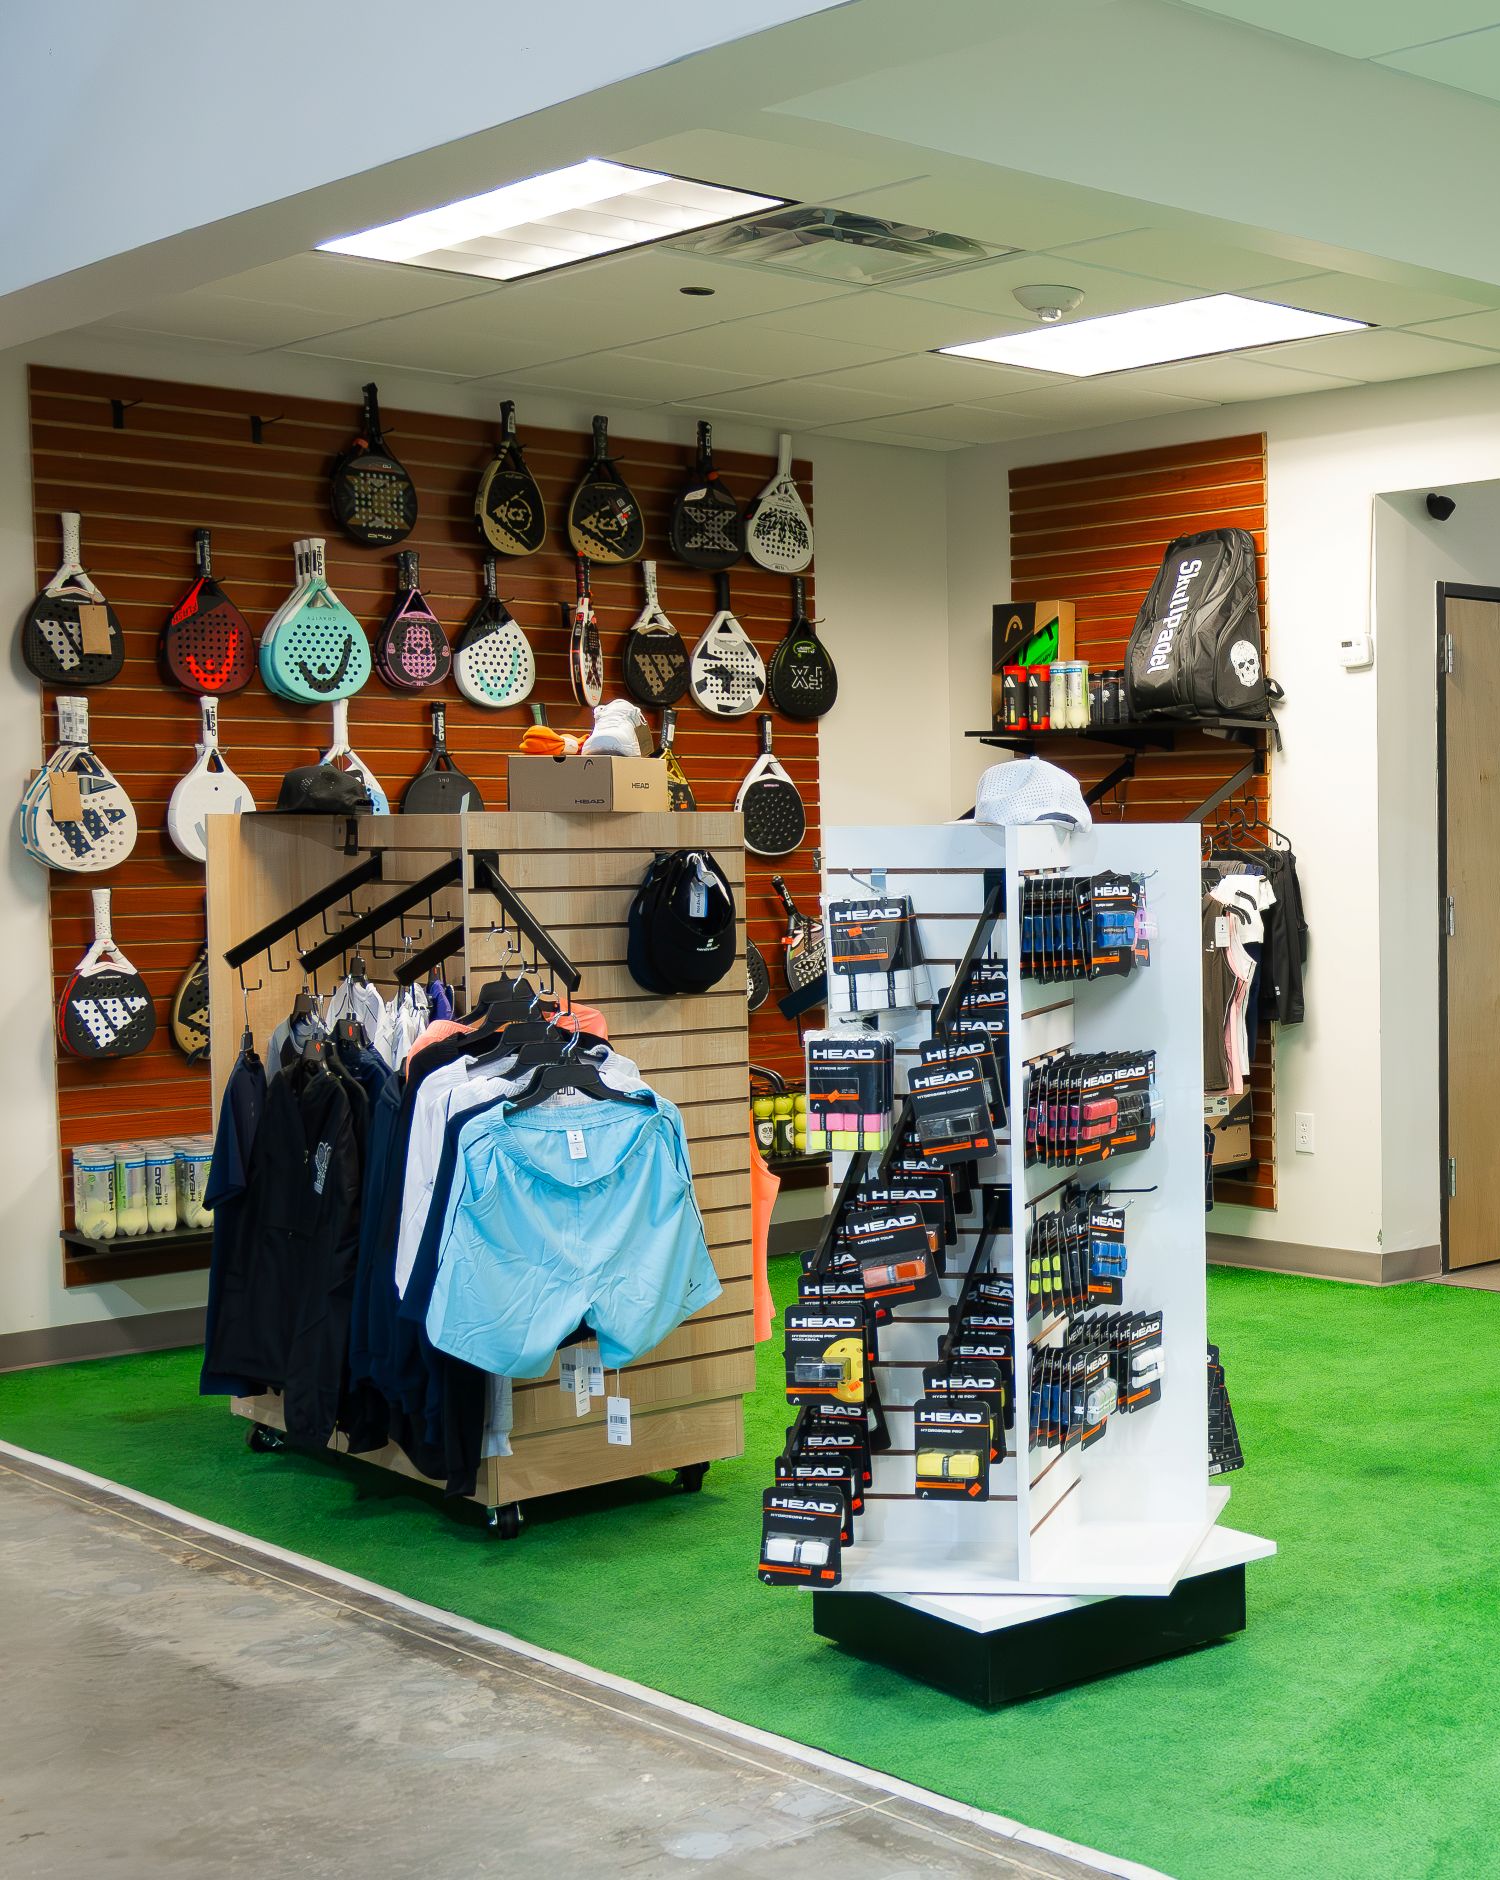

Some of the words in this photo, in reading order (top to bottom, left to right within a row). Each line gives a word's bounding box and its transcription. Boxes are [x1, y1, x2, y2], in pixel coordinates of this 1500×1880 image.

[1094, 886, 1129, 896] HEAD
[834, 908, 902, 922] HEAD
[812, 1049, 875, 1060] HEAD
[914, 1069, 974, 1088] HEAD
[1084, 1074, 1112, 1088] HEAD
[872, 1190, 936, 1200] HEAD
[854, 1215, 916, 1234] HEAD
[1092, 1216, 1122, 1228] HEAD
[791, 1318, 856, 1328] HEAD
[970, 1316, 1014, 1326] EAD
[1132, 1322, 1160, 1340] HEAD
[960, 1346, 1005, 1356] EAD
[1086, 1354, 1108, 1374] HEAD
[931, 1378, 995, 1389] HEAD
[820, 1404, 862, 1416] EAD
[920, 1412, 982, 1422] HEAD
[808, 1436, 855, 1446] EAD
[771, 1498, 837, 1513] HEAD
